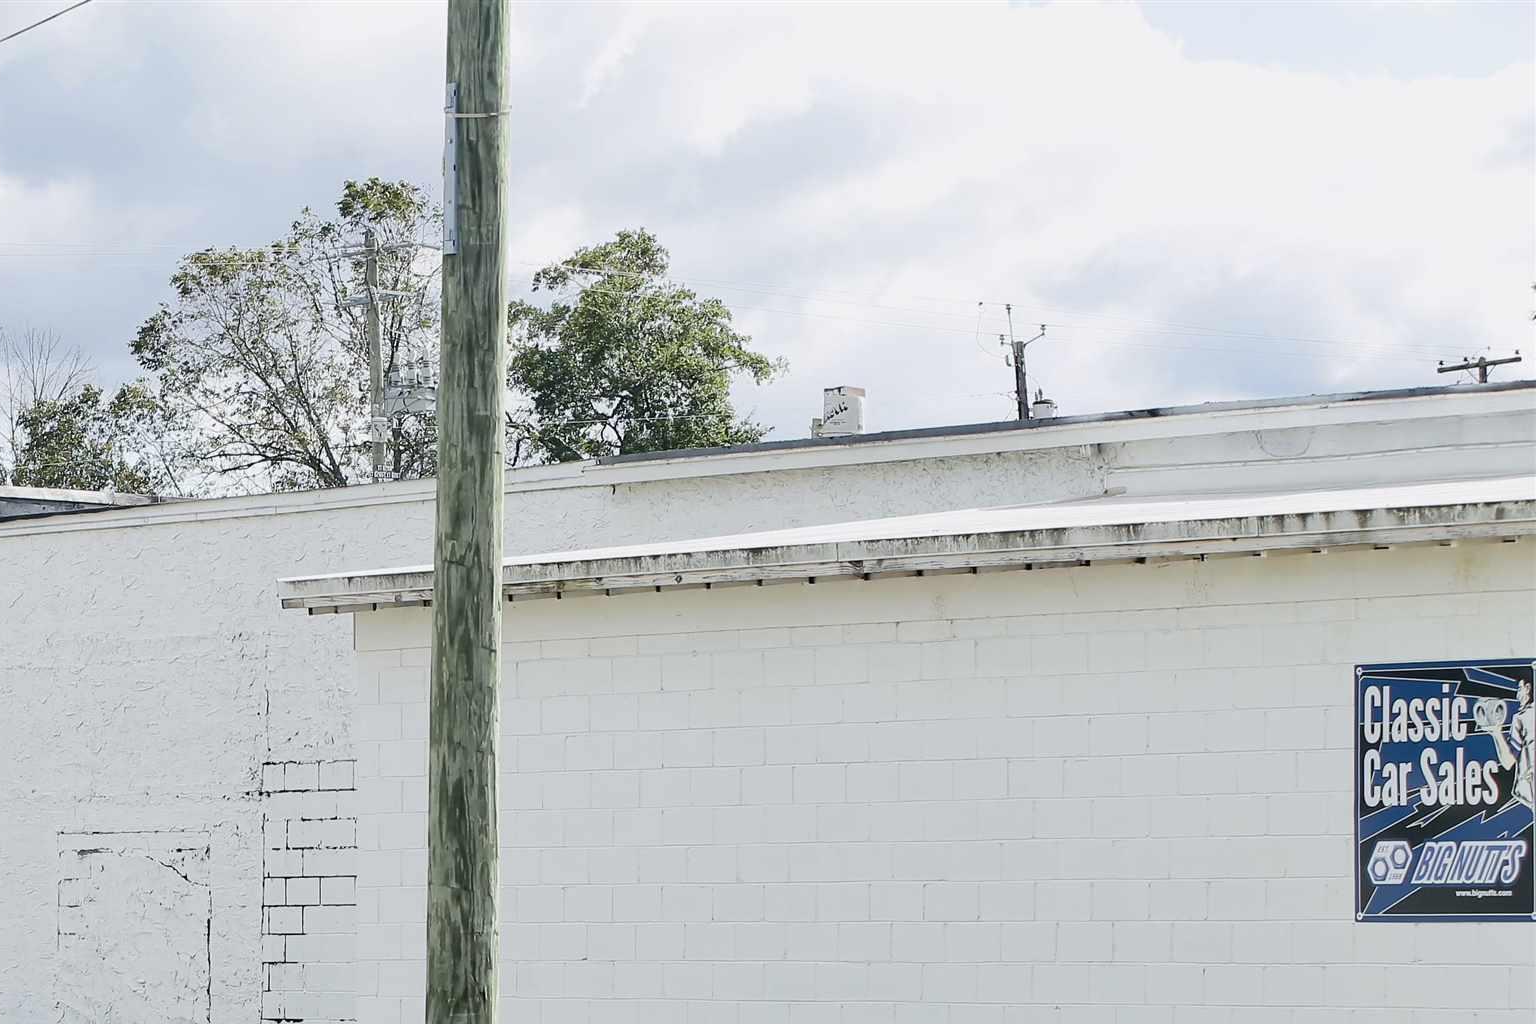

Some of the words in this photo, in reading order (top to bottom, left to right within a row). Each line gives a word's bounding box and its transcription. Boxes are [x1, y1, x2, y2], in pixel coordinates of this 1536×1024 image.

[1364, 684, 1467, 743] Classic
[1364, 748, 1412, 807] Car
[1421, 747, 1499, 806] Sales
[1413, 843, 1455, 883] BIG
